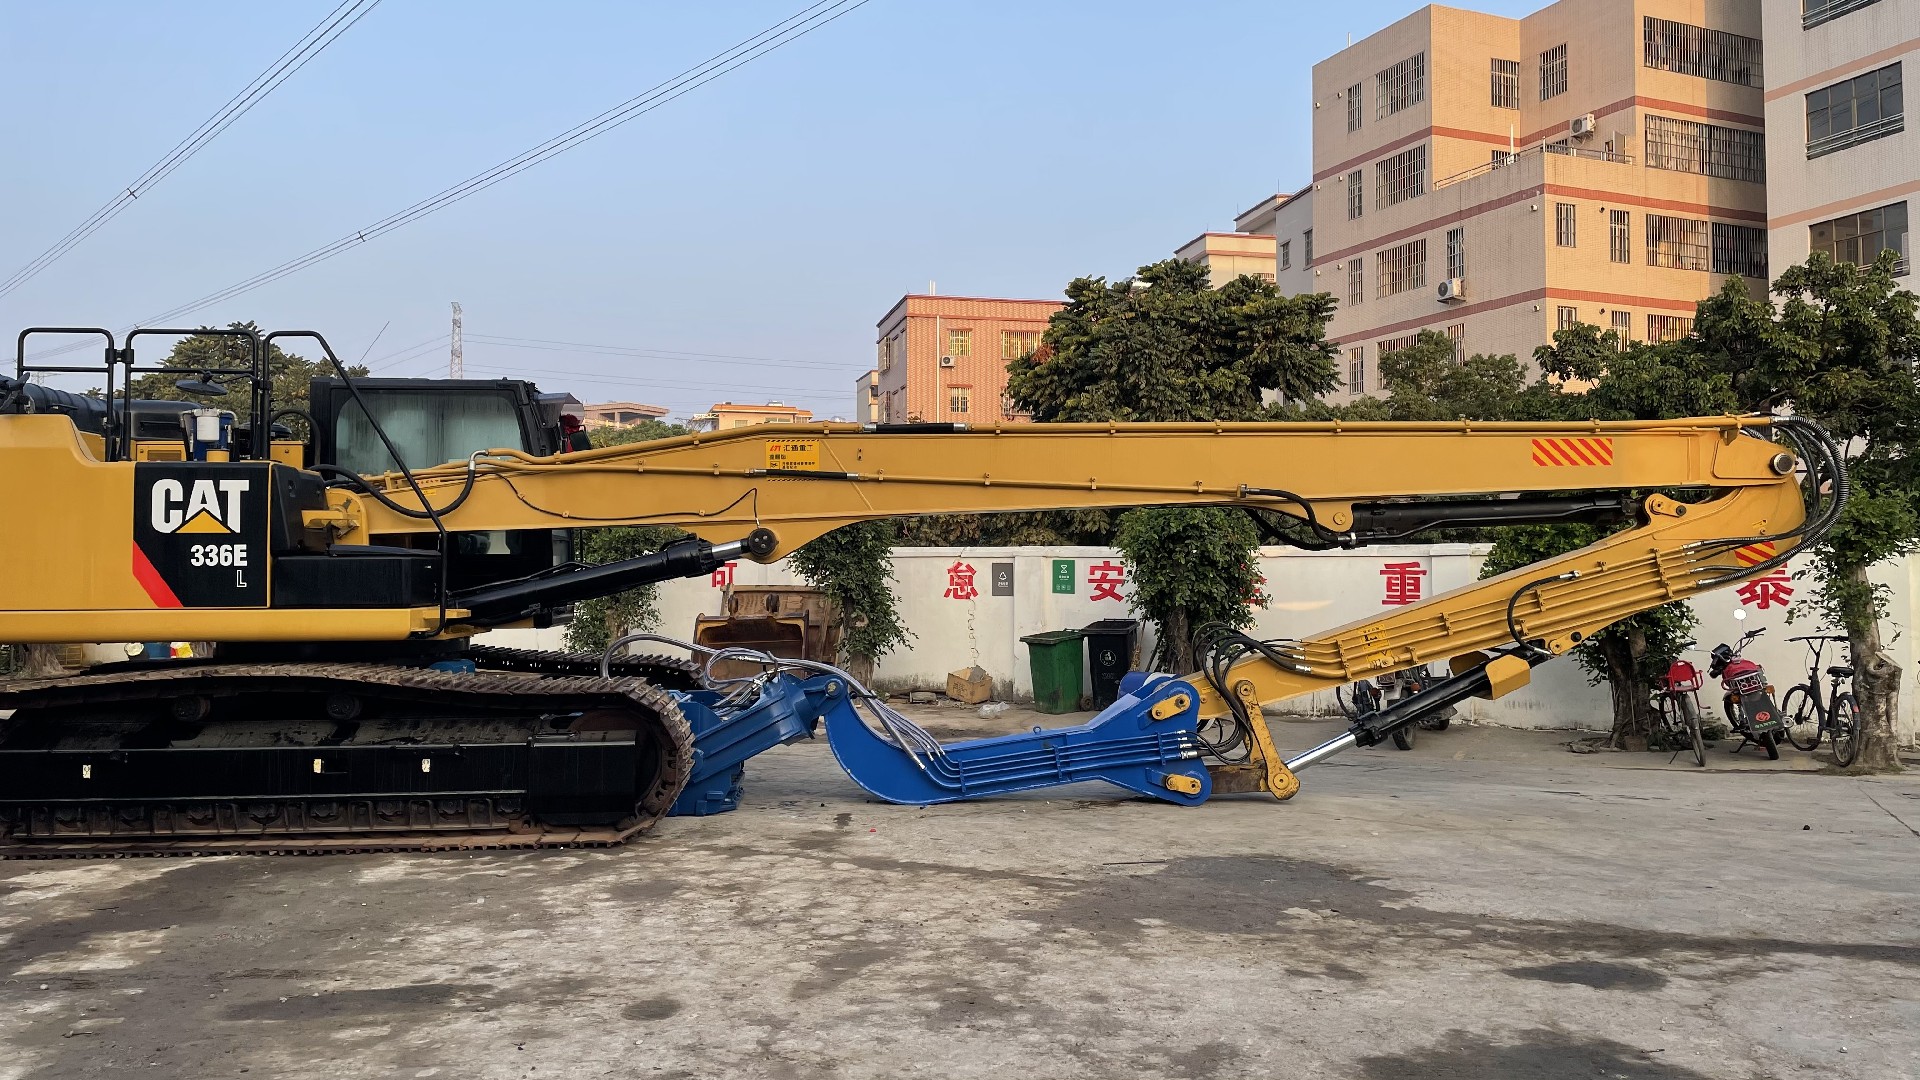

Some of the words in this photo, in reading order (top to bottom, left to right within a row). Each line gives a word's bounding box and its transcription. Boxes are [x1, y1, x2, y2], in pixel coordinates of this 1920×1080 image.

[151, 479, 250, 533] CAT
[190, 544, 248, 567] 336E
[236, 569, 247, 588] L
[943, 561, 979, 600] 怠
[1087, 560, 1126, 602] 安
[1379, 561, 1427, 605] 重
